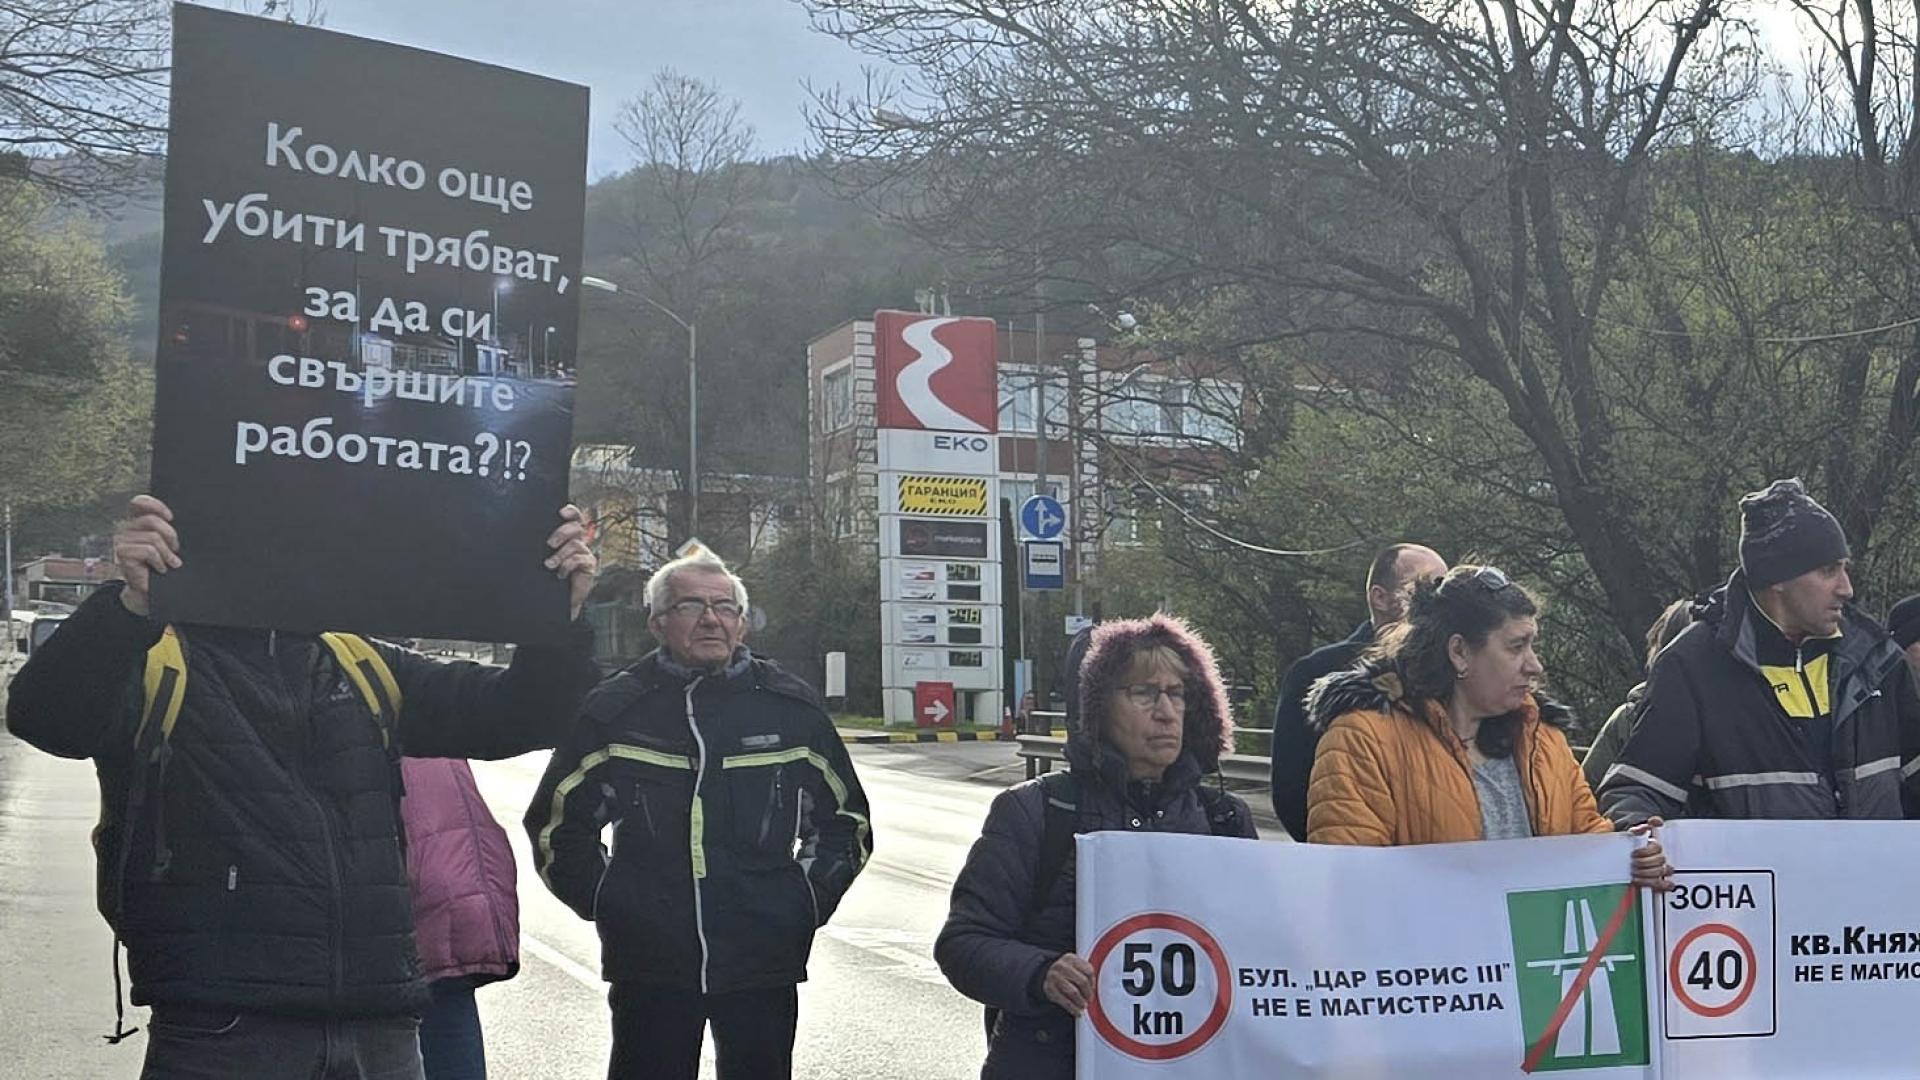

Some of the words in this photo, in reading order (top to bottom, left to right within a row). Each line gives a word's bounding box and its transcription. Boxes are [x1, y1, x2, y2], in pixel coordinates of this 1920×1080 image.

[265, 121, 426, 191] Колко
[438, 167, 534, 214] още
[202, 193, 365, 253] убити
[379, 226, 570, 294] трябват,
[304, 286, 359, 323] за
[370, 297, 429, 337] да
[441, 306, 492, 341] си
[268, 354, 515, 412] свършите
[934, 436, 989, 453] EKO
[907, 485, 977, 498] ГАРАНЦИЯ
[1669, 884, 1756, 910] ЗОНА
[1121, 943, 1196, 997] 50
[1238, 968, 1297, 987] БУЛ.
[1376, 968, 1468, 988] БОРИС
[1687, 950, 1742, 991] 40
[1795, 966, 1824, 983] НЕ
[1831, 964, 1843, 981] Е
[1133, 1004, 1184, 1036] km
[1252, 997, 1287, 1017] НЕ
[1296, 999, 1312, 1017] Е
[1321, 992, 1504, 1016] МАГИСТРАЛА
